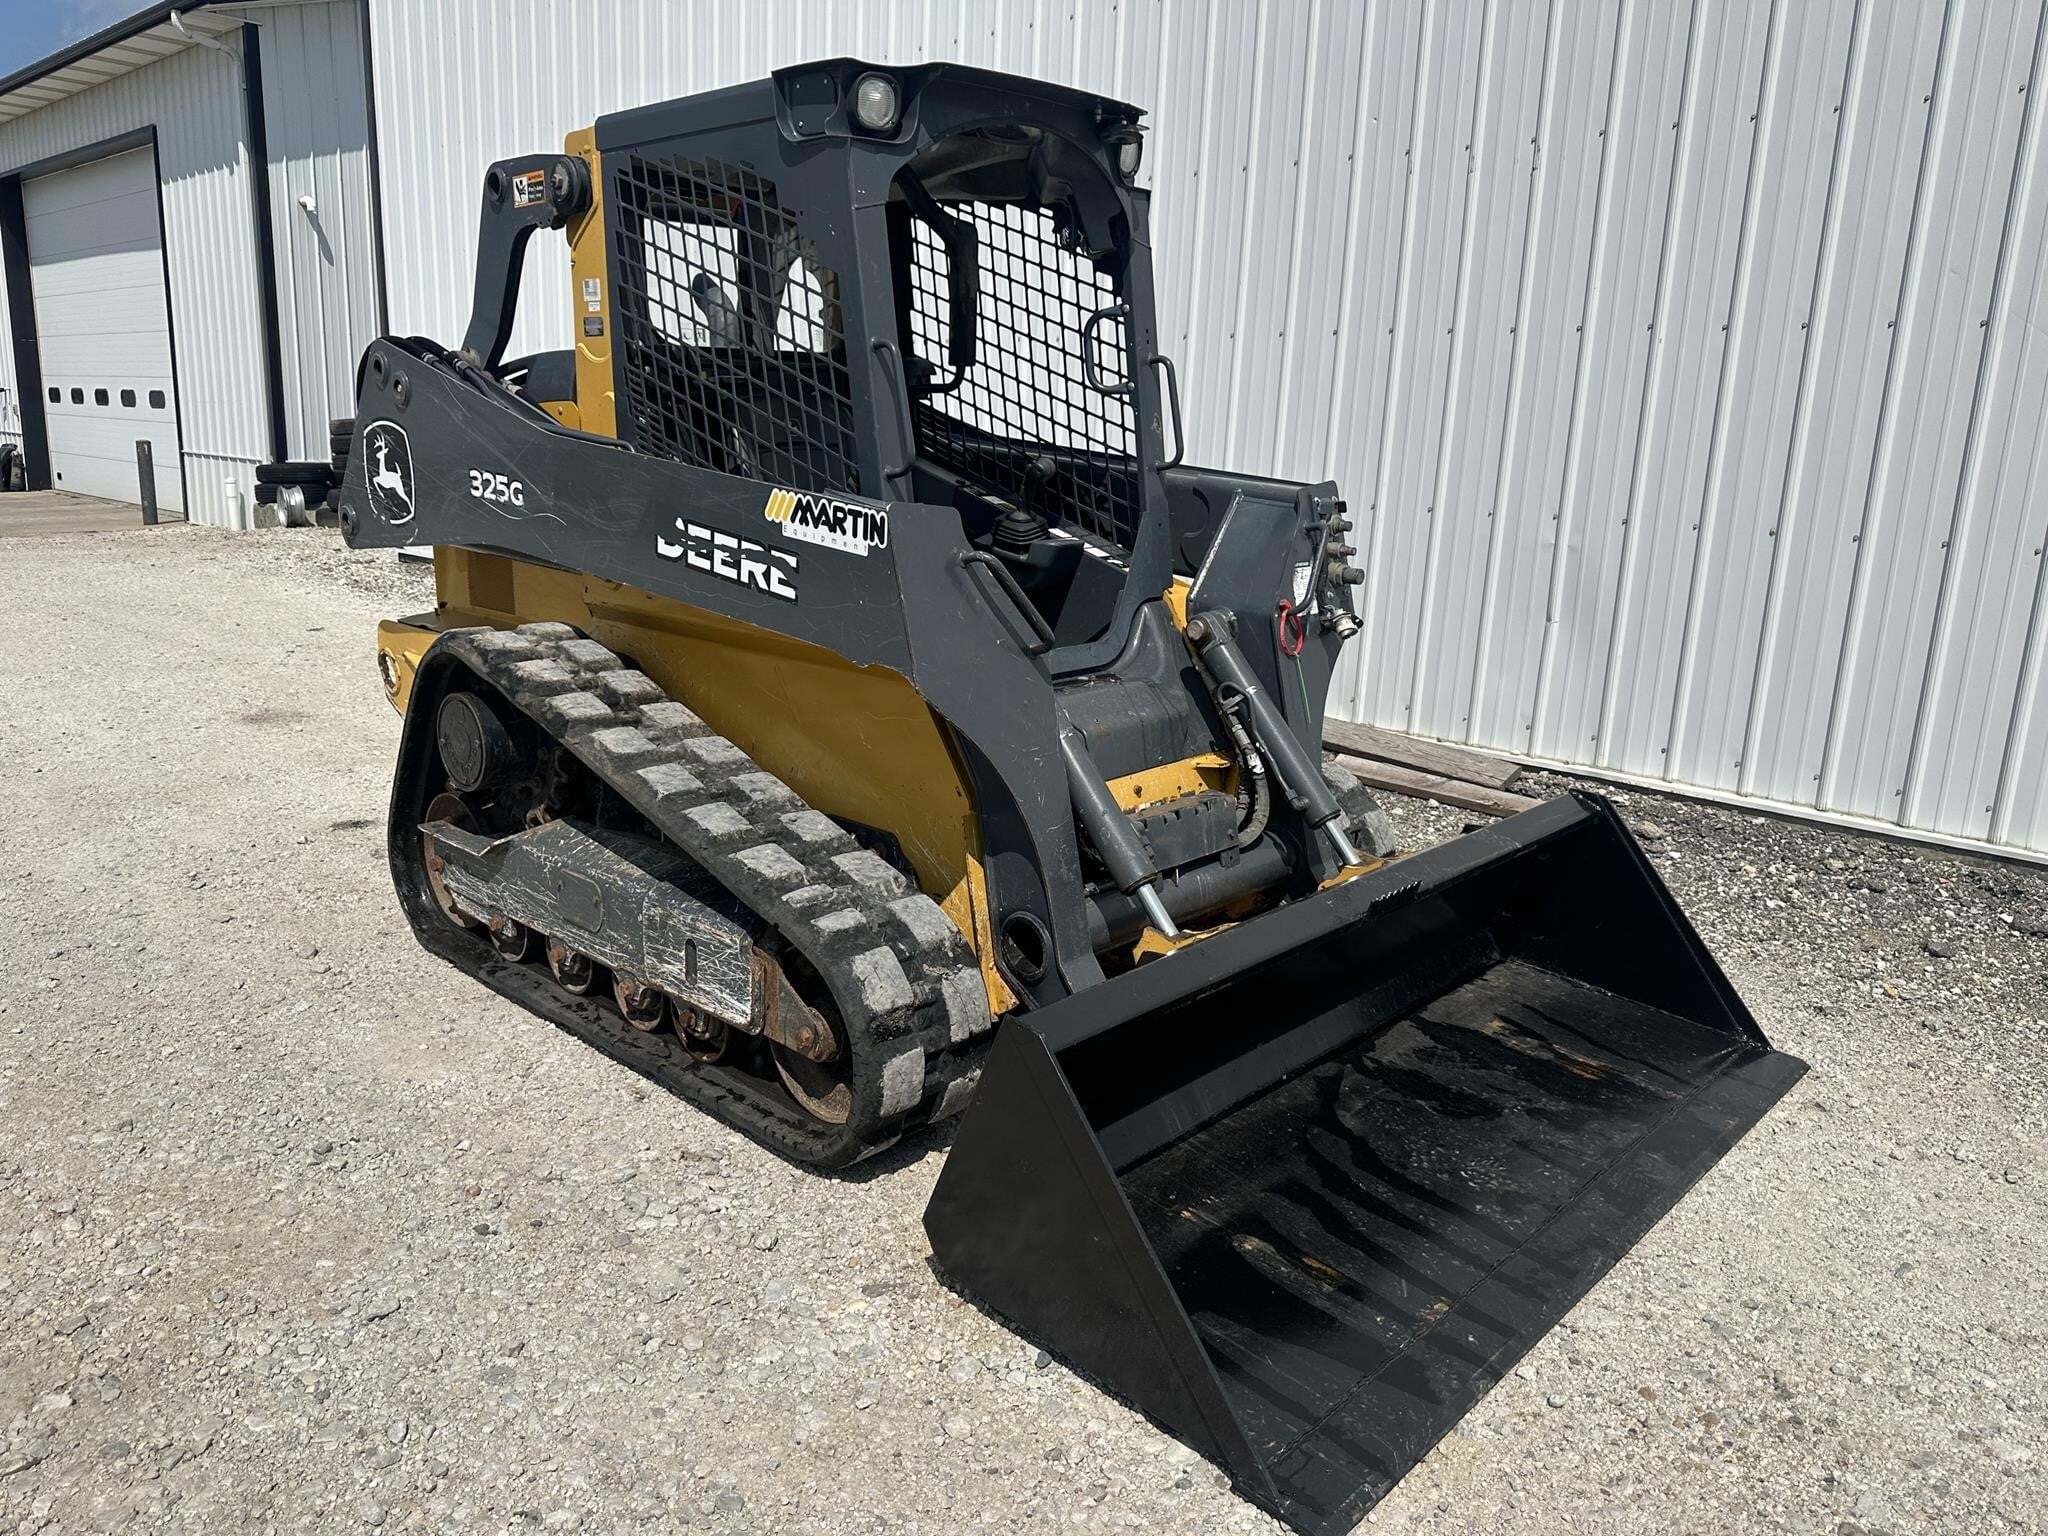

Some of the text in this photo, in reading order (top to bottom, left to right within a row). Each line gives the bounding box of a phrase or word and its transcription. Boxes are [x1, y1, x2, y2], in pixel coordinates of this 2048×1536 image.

[470, 469, 524, 506] 325G
[783, 524, 868, 553] Equipment
[790, 497, 886, 546] MARTIN
